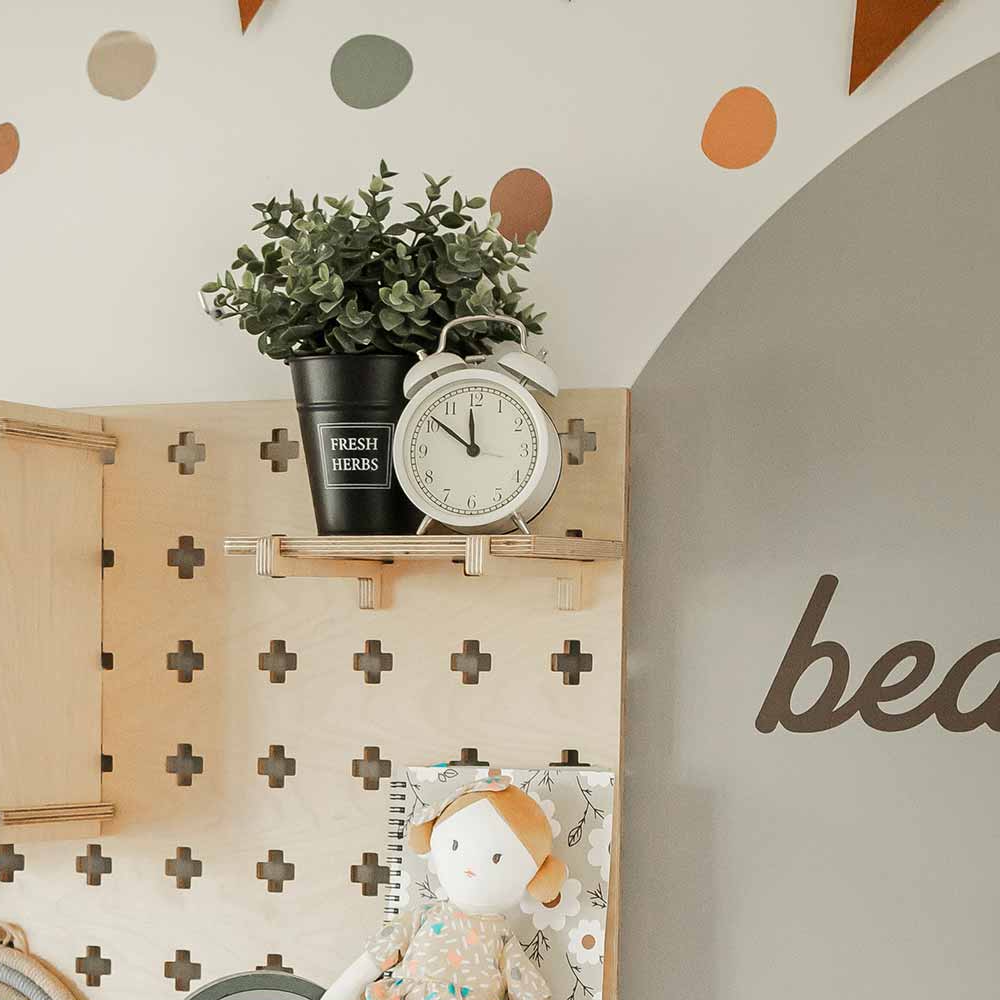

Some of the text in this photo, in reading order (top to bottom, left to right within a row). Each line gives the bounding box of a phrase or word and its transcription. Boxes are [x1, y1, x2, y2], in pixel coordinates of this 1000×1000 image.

[469, 393, 484, 408] 12
[497, 401, 503, 414] 1
[444, 402, 457, 416] 11
[425, 419, 440, 433] 10
[514, 419, 524, 433] 2
[330, 437, 379, 451] FRESH
[418, 444, 428, 459] 9
[519, 443, 529, 458] 3
[331, 458, 379, 471] HERBS
[423, 470, 434, 485] 8
[514, 469, 522, 484] 4
[442, 488, 451, 504] 7
[466, 494, 477, 509] 6
[492, 488, 503, 504] 5
